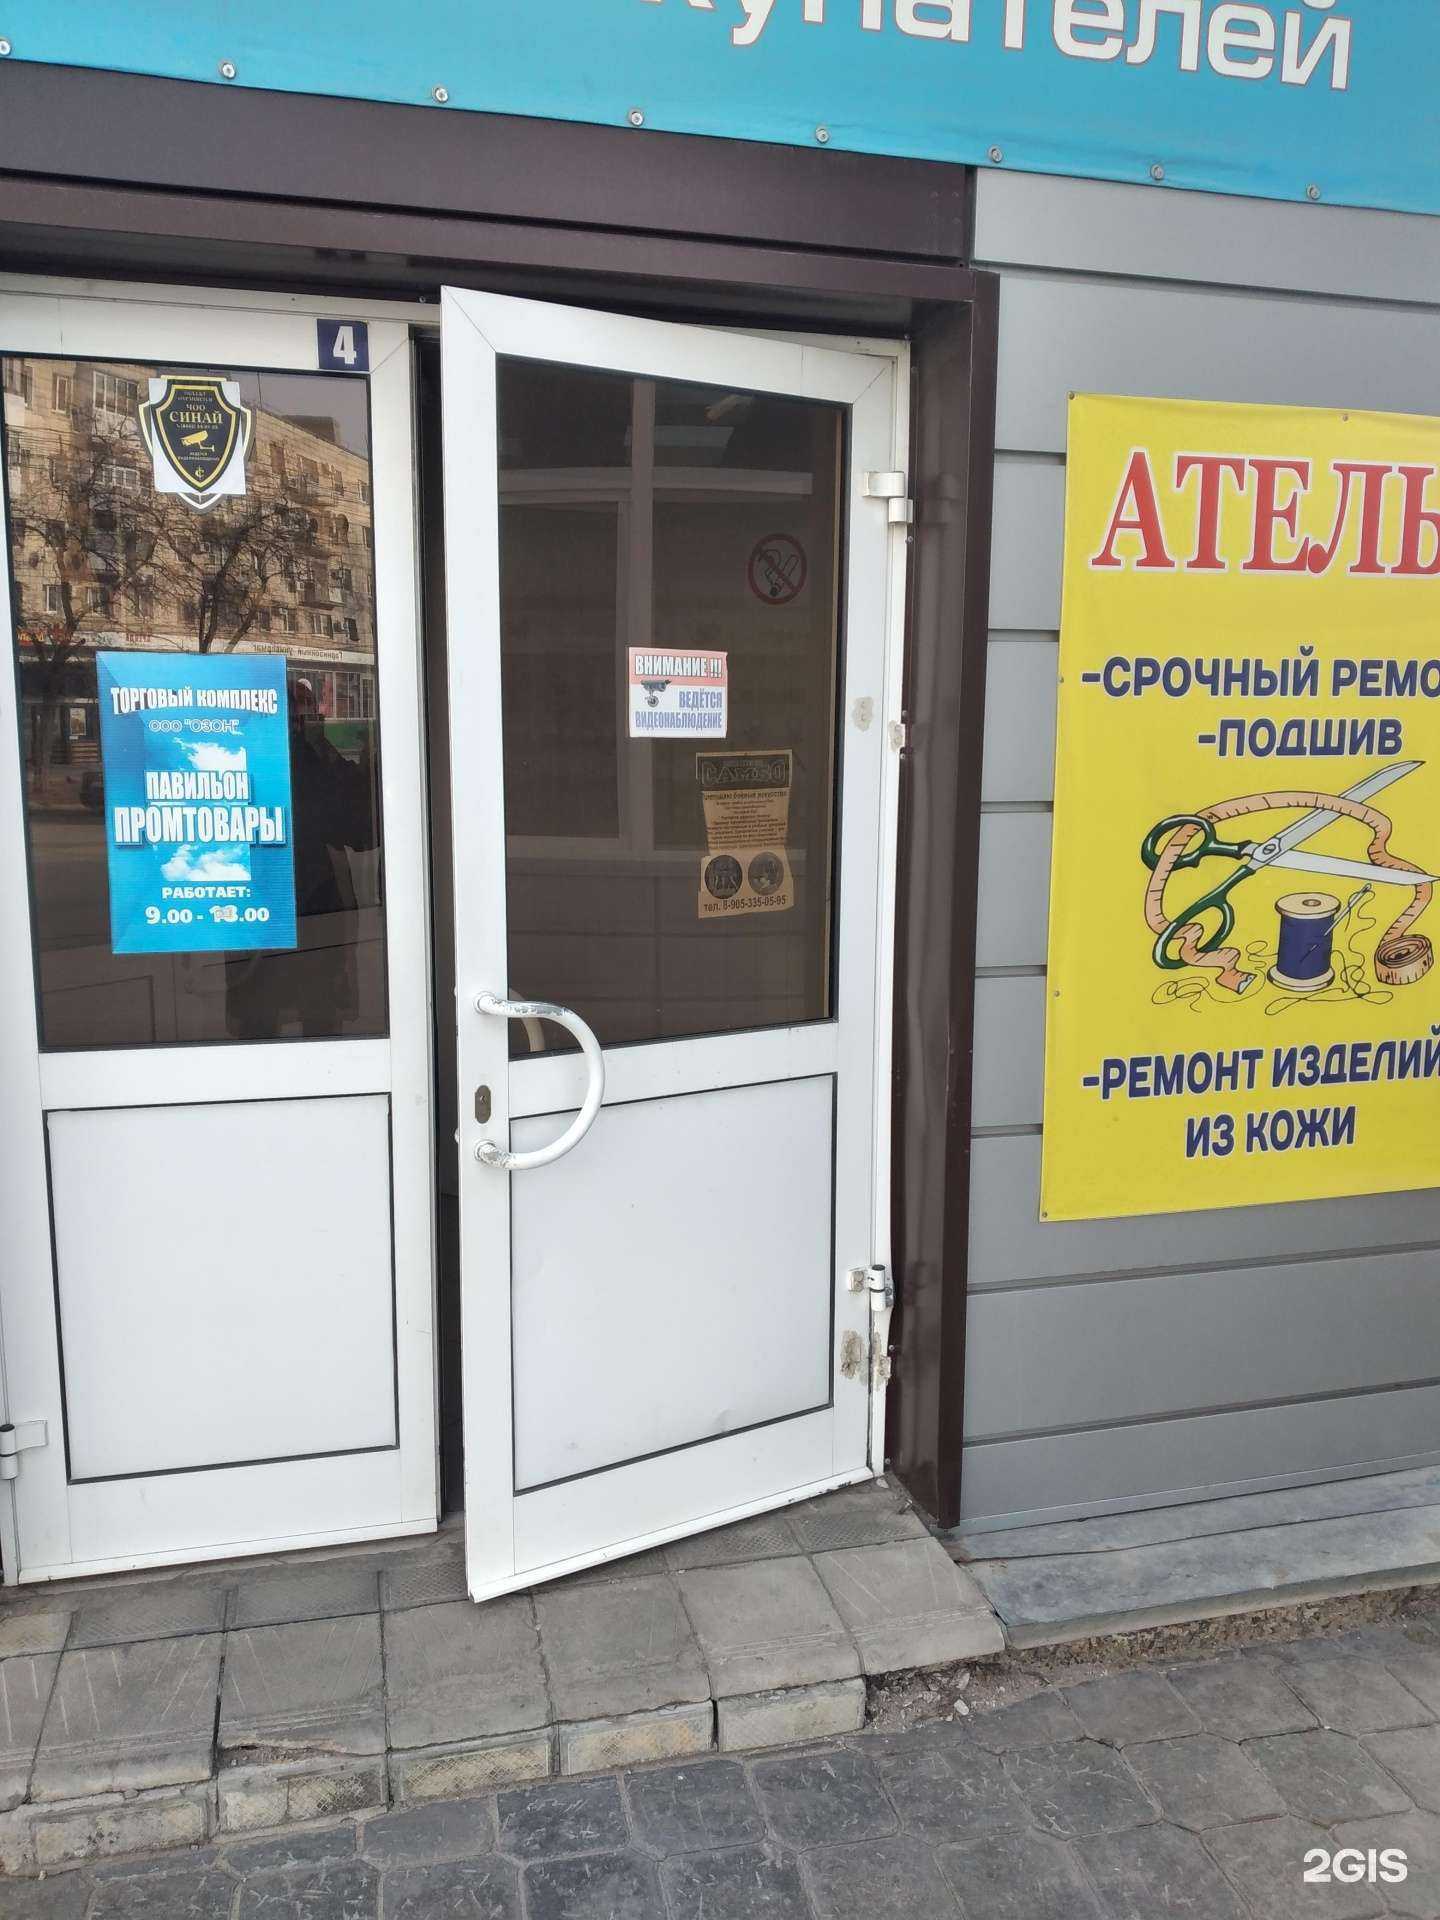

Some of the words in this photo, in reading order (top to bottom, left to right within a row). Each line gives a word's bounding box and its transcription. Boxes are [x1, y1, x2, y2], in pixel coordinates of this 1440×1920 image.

[640, 0, 1352, 90] ателей
[332, 325, 357, 365] 4
[169, 410, 224, 424] СИНАЙ
[1090, 450, 1440, 575] АТЕЛЬ
[635, 655, 707, 677] ВНИМАНИЕ
[1331, 659, 1440, 696] РЕМО
[110, 686, 193, 715] ТОРГОВЫЙ
[196, 688, 278, 714] КОМПЛЕКС
[679, 688, 722, 710] ВЕДЁТСЯ
[149, 719, 182, 733] ООО
[635, 711, 722, 730] ВИДЕОНАБЛЮДЕНИЕ
[146, 771, 249, 800] ПАВИЛЬОН
[114, 806, 286, 842] ПРОМТОВАРЫ
[162, 887, 251, 899] РАБОТАЕТ:
[145, 906, 193, 925] 9.00
[1272, 1025, 1440, 1088] ИЗДЕЛИЙ
[1186, 1115, 1235, 1158] ИЗ
[1246, 1106, 1356, 1153] КОЖИ
